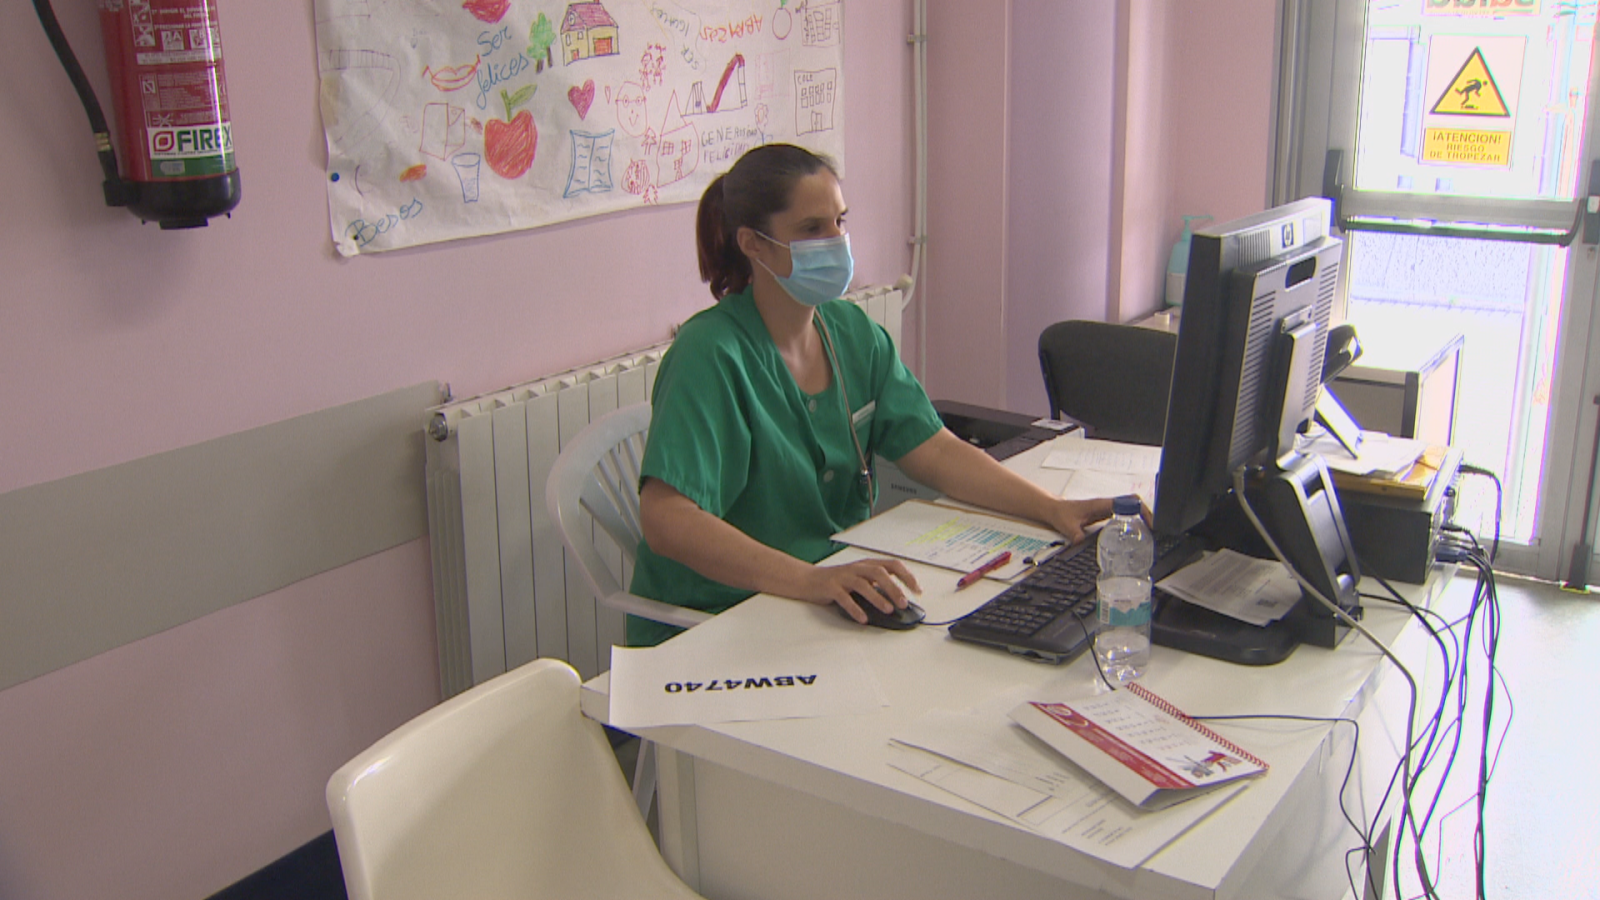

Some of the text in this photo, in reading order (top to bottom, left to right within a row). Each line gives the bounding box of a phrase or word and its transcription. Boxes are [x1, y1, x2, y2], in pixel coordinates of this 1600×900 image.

[476, 53, 529, 110] felices
[176, 126, 232, 151] FIREX
[1446, 143, 1485, 152] RIESGO
[1430, 151, 1501, 162] DE TROPEZAR
[345, 198, 423, 247] Besos
[664, 675, 817, 693] ABW4740
